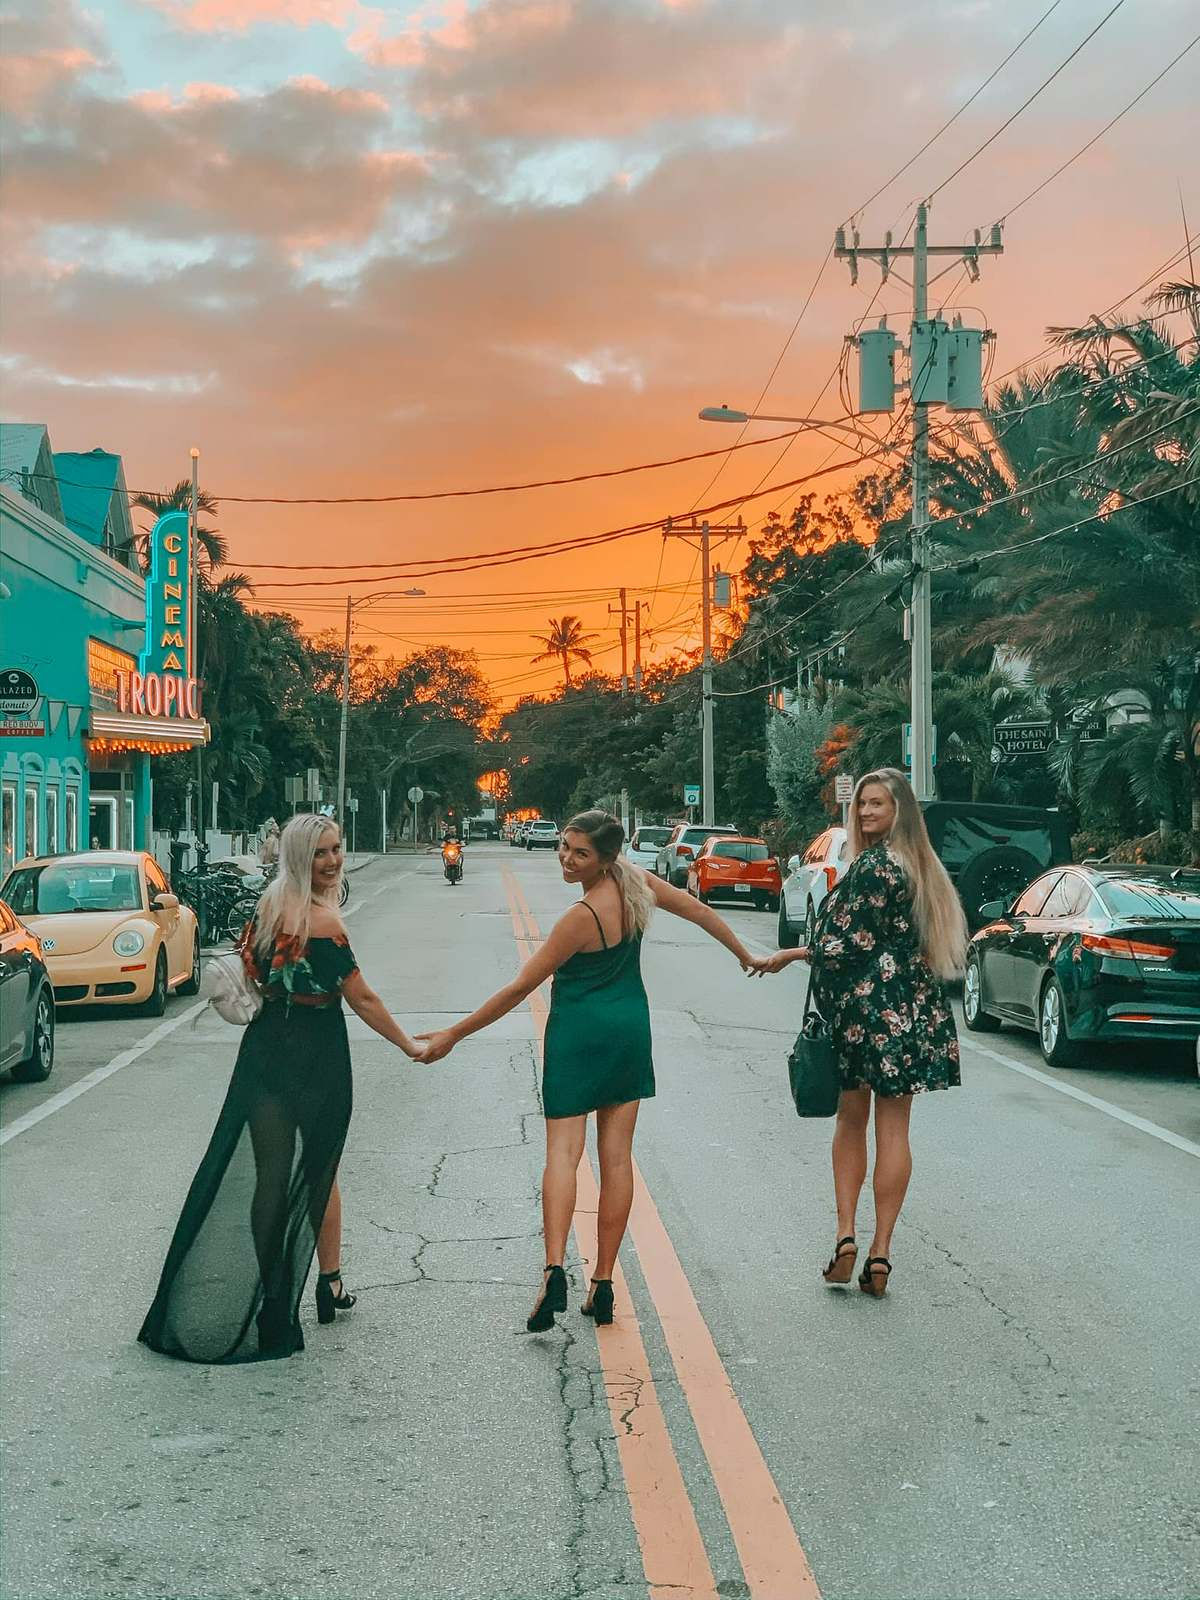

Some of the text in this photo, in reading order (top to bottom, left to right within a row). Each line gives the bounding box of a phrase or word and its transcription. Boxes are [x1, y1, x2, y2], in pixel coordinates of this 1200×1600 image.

[161, 534, 185, 670] CINEMA
[113, 669, 200, 720] TROPIC
[997, 729, 1020, 741] THE
[1007, 740, 1046, 751] HOTEL
